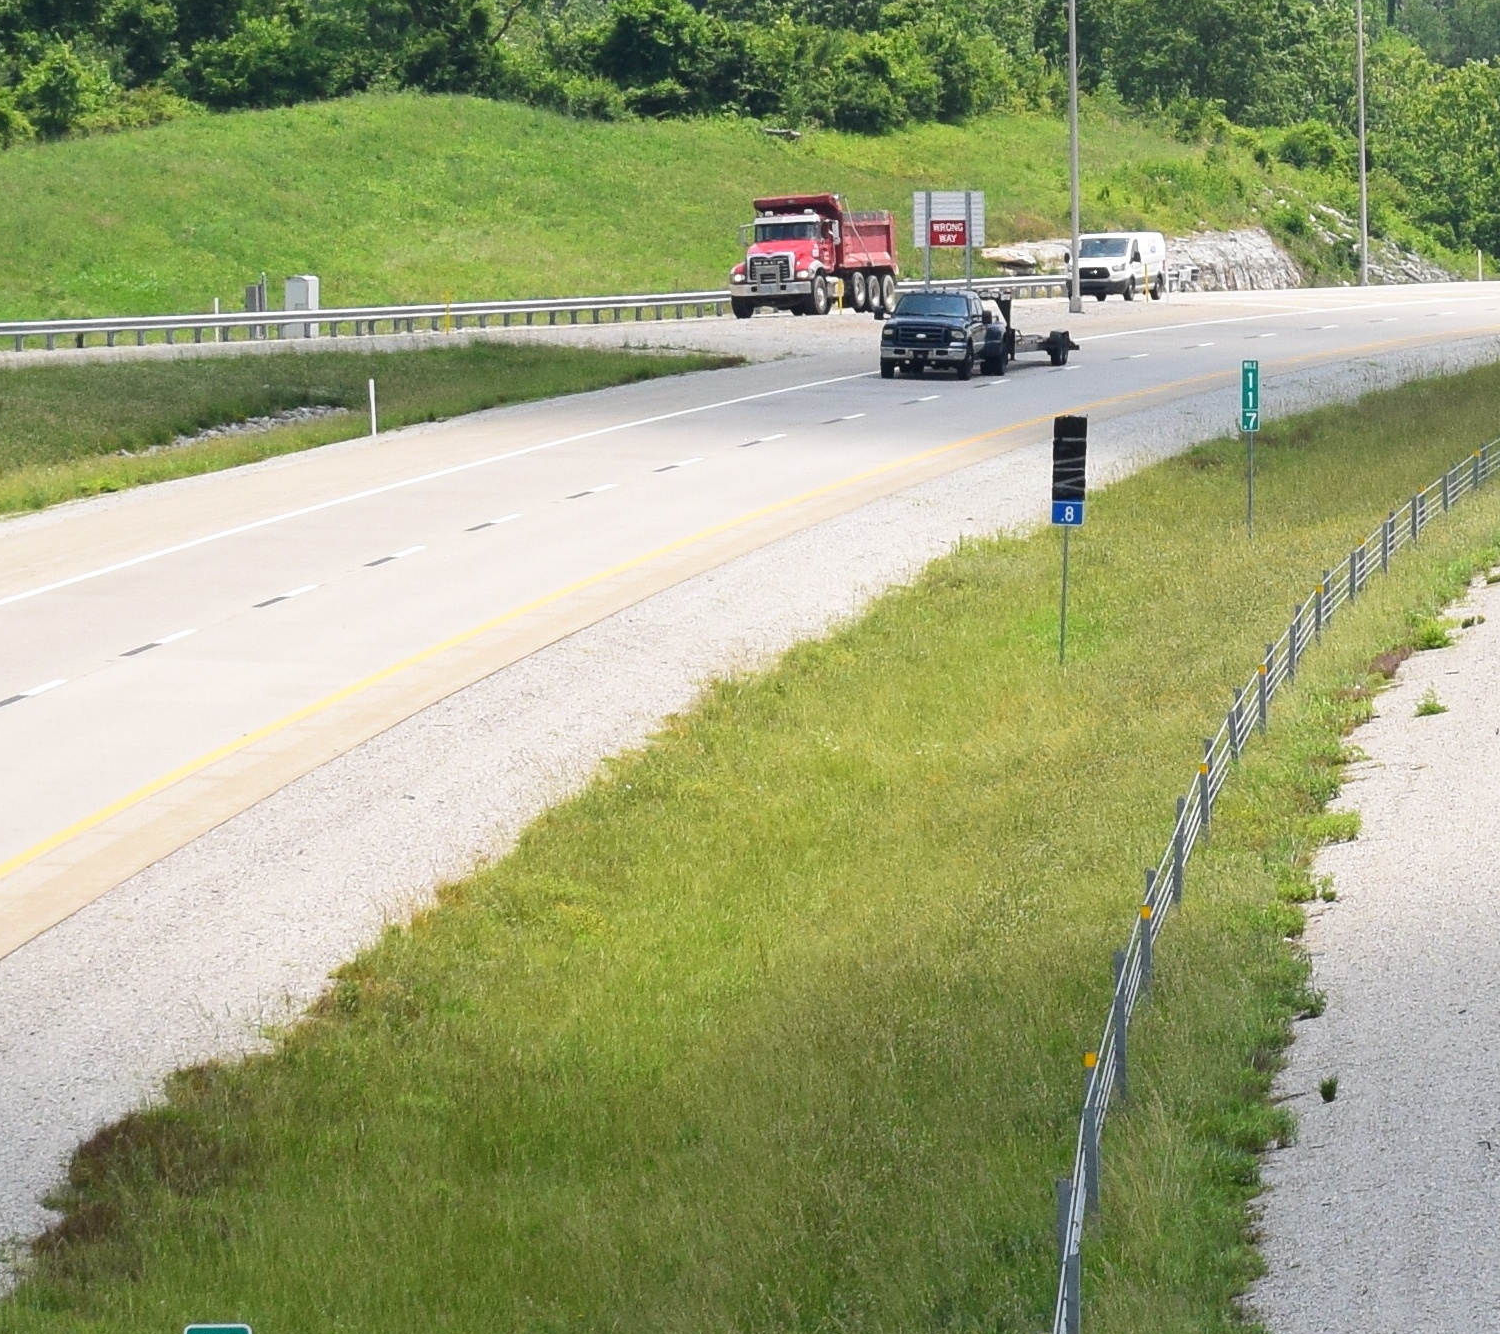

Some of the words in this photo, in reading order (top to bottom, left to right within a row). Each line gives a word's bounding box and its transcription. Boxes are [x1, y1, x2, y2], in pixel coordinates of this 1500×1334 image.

[933, 223, 964, 232] WRONG
[939, 234, 958, 243] WAY
[1243, 412, 1257, 430] .7
[1061, 505, 1074, 522] .8
